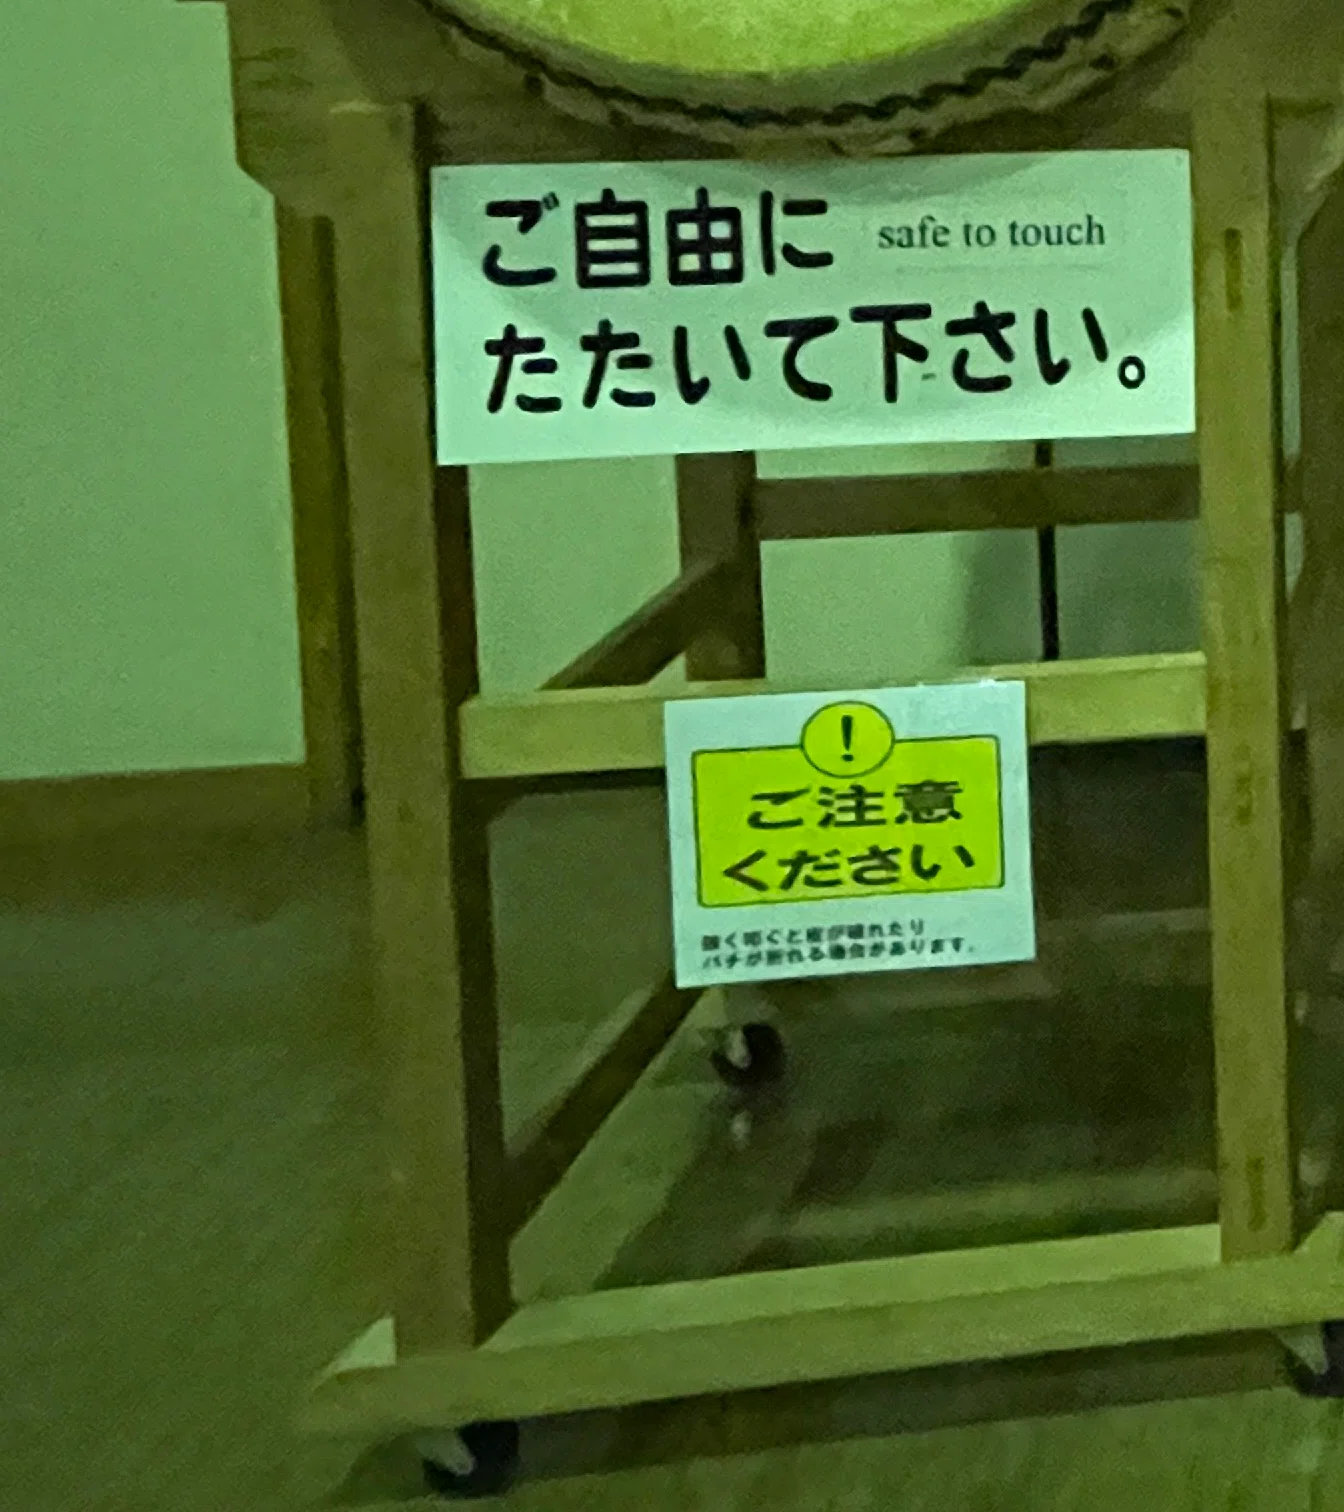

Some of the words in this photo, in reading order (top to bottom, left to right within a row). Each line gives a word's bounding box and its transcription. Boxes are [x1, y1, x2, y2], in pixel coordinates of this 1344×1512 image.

[483, 186, 833, 289] ご自由に
[878, 215, 951, 249] safe
[963, 222, 997, 248] to
[1008, 214, 1106, 247] touch
[484, 300, 1146, 414] たたいて下さい。
[747, 779, 963, 830] ご注意
[722, 843, 976, 892] ください
